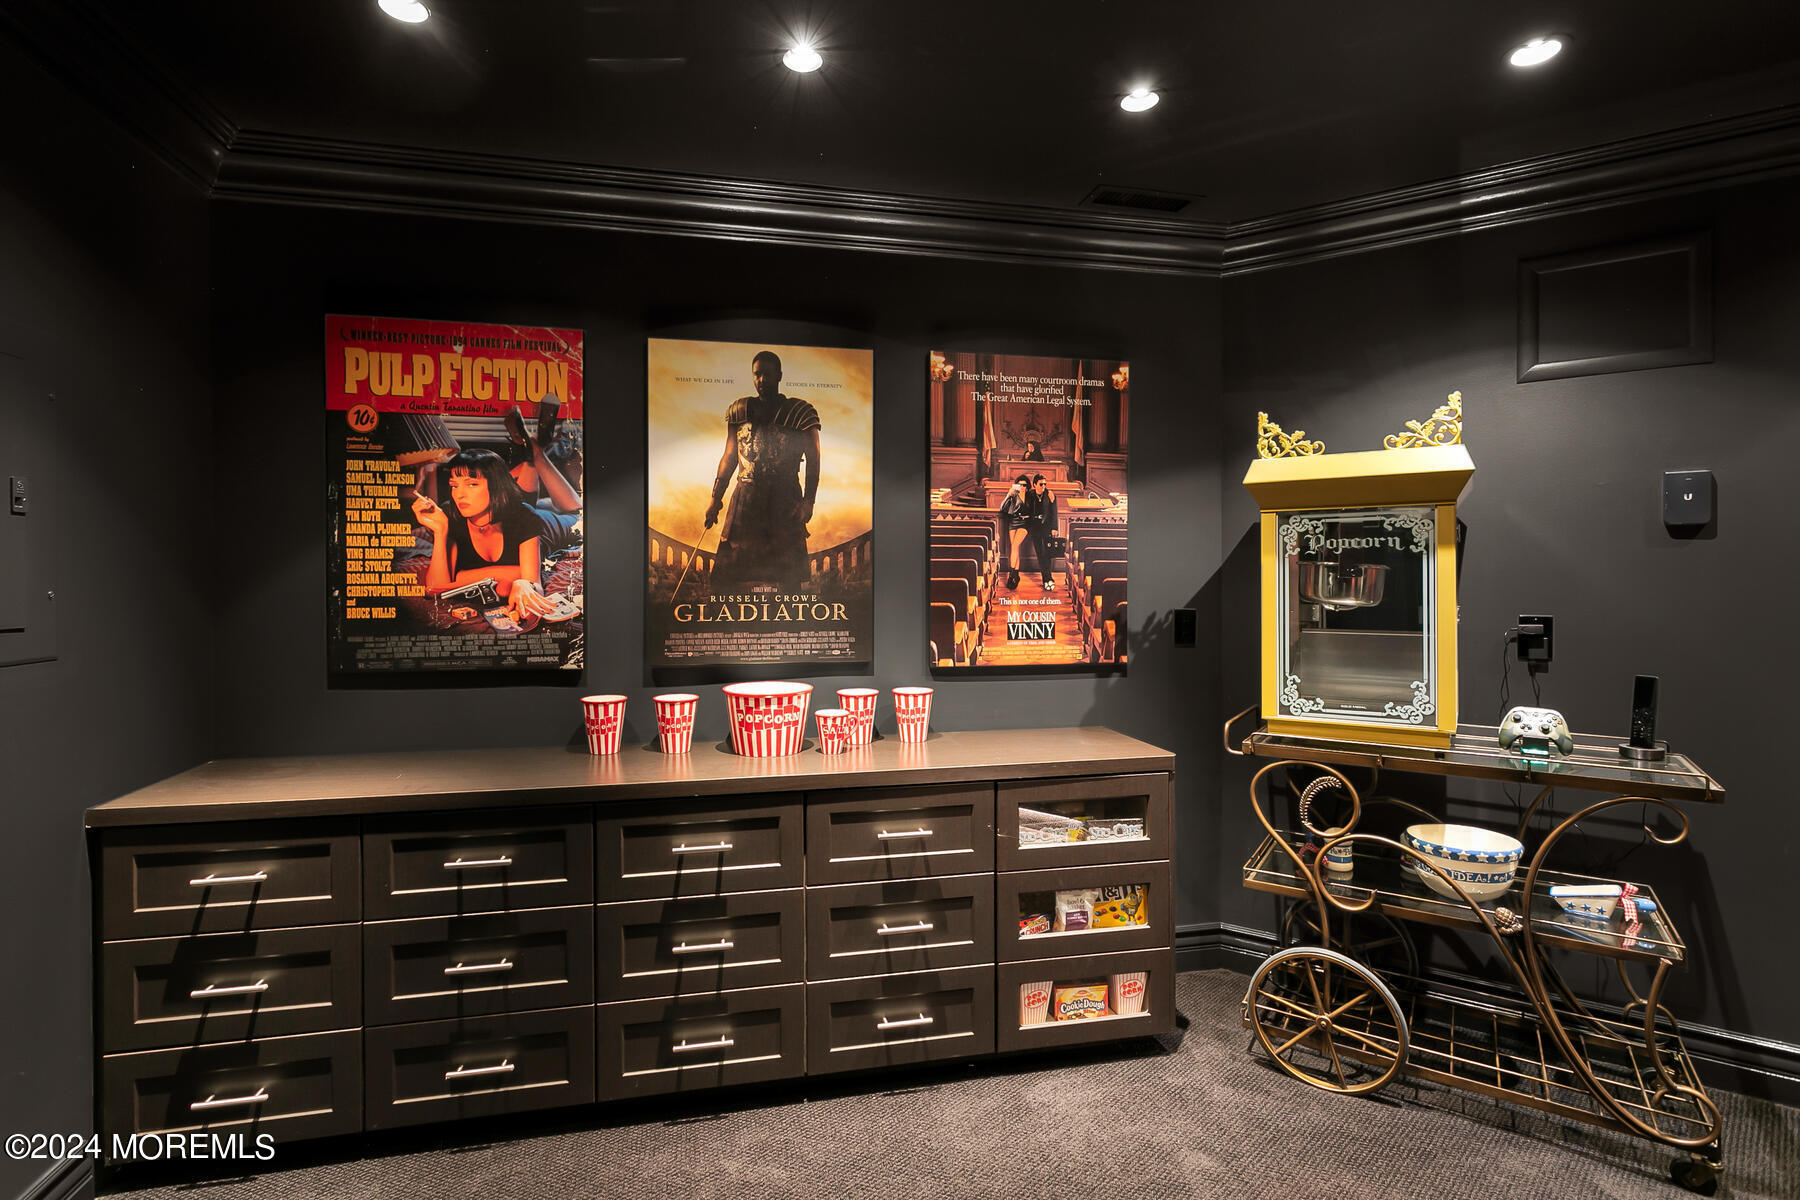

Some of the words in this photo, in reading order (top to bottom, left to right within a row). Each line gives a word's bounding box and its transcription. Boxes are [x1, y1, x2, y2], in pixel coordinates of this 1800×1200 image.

[504, 338, 522, 350] FILM
[344, 347, 434, 397] PULP
[439, 352, 568, 404] FICTION
[958, 370, 980, 380] There
[982, 372, 998, 382] have
[1000, 372, 1018, 382] been
[1018, 376, 1038, 386] many
[1040, 376, 1078, 386] courtroom
[1078, 376, 1104, 386] dramas
[1000, 382, 1015, 392] that
[1016, 384, 1033, 394] have
[1034, 384, 1064, 396] glorified
[971, 392, 986, 401] The
[987, 392, 1008, 402] Great
[1010, 394, 1044, 404] American
[1046, 395, 1065, 407] Legal
[1066, 396, 1092, 408] System.
[408, 400, 440, 412] Quentin
[442, 402, 480, 412] Tarantino
[482, 404, 498, 414] film
[346, 460, 364, 471] JOHN
[366, 460, 400, 472] TRAVOLTA
[346, 472, 374, 484] SAMUEL
[376, 473, 383, 484] L.
[385, 474, 414, 484] JACKSON
[346, 485, 362, 496] UMA
[363, 486, 398, 496] THURMAN
[346, 498, 374, 509] HARVEY
[376, 498, 400, 510] KEITEL
[346, 510, 360, 522] TIM
[362, 510, 381, 522] ROTH
[346, 522, 376, 534] AMANDA
[377, 523, 412, 534] PLUMMER
[346, 536, 370, 546] MARIA
[370, 536, 380, 546] de
[380, 536, 416, 547] MEDEIROS
[1304, 532, 1405, 554] Popcorn
[346, 548, 364, 560] VING
[364, 548, 394, 560] RHAMES
[346, 560, 364, 572] ERIC
[364, 560, 392, 572] STOLTZ
[346, 573, 380, 584] ROSANNA
[381, 573, 418, 584] ARQUETTE
[346, 586, 396, 597] CHRISTOPHER
[396, 586, 426, 596] WALKEN
[710, 594, 768, 602] RUSSELL
[999, 597, 1012, 606] This
[1040, 596, 1046, 605] of
[1046, 596, 1062, 605] them.
[346, 608, 370, 618] BRUCE
[372, 608, 396, 618] WILLIS
[674, 603, 848, 622] GLADIATOR
[1008, 622, 1055, 640] VINNY
[737, 708, 800, 724] POPCORN
[1026, 922, 1049, 936] CRUNCH
[1122, 982, 1138, 990] POP
[1122, 986, 1143, 995] CORN
[1026, 992, 1042, 1001] POP
[1027, 996, 1048, 1006] CORN
[1060, 1000, 1084, 1014] Cookie
[1084, 998, 1106, 1010] Dough
